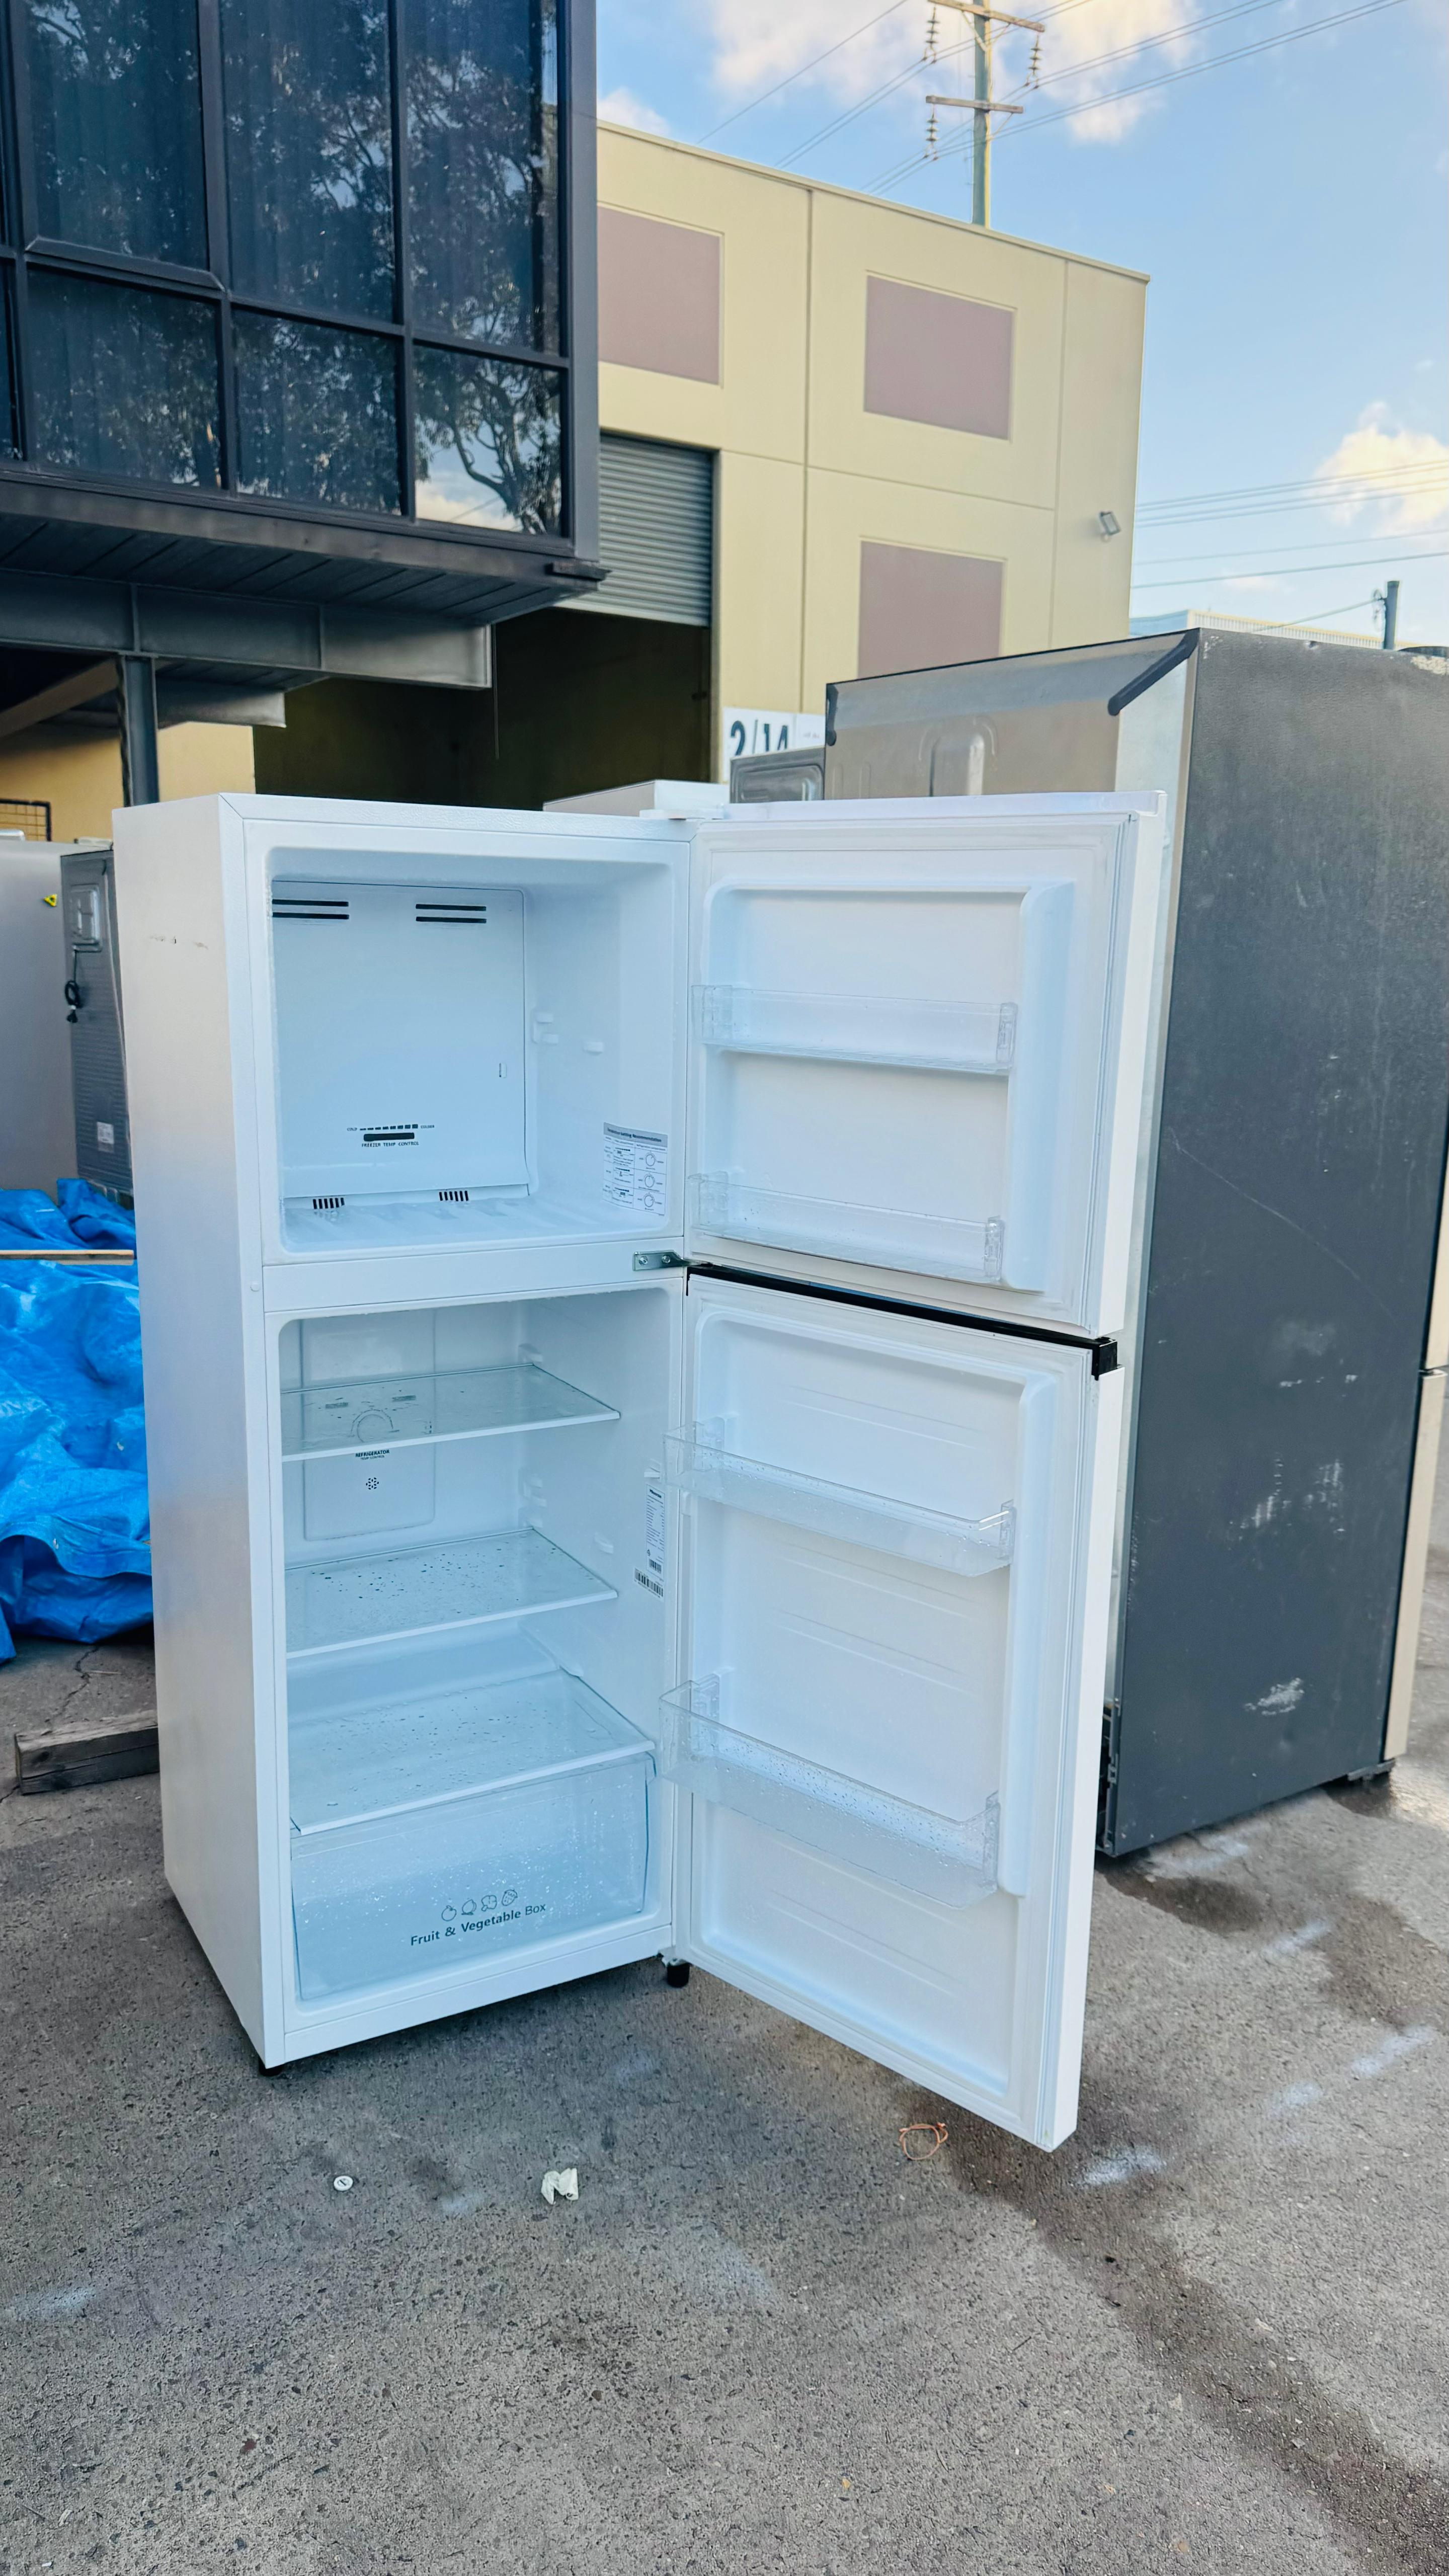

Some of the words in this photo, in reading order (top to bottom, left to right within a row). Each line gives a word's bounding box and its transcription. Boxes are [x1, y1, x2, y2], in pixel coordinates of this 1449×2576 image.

[355, 1449, 390, 1458] REFRIGERATOR
[411, 1930, 440, 1946] Fruit
[445, 1926, 456, 1937] &
[461, 1909, 521, 1933] Vegetable
[525, 1903, 546, 1916] Box
